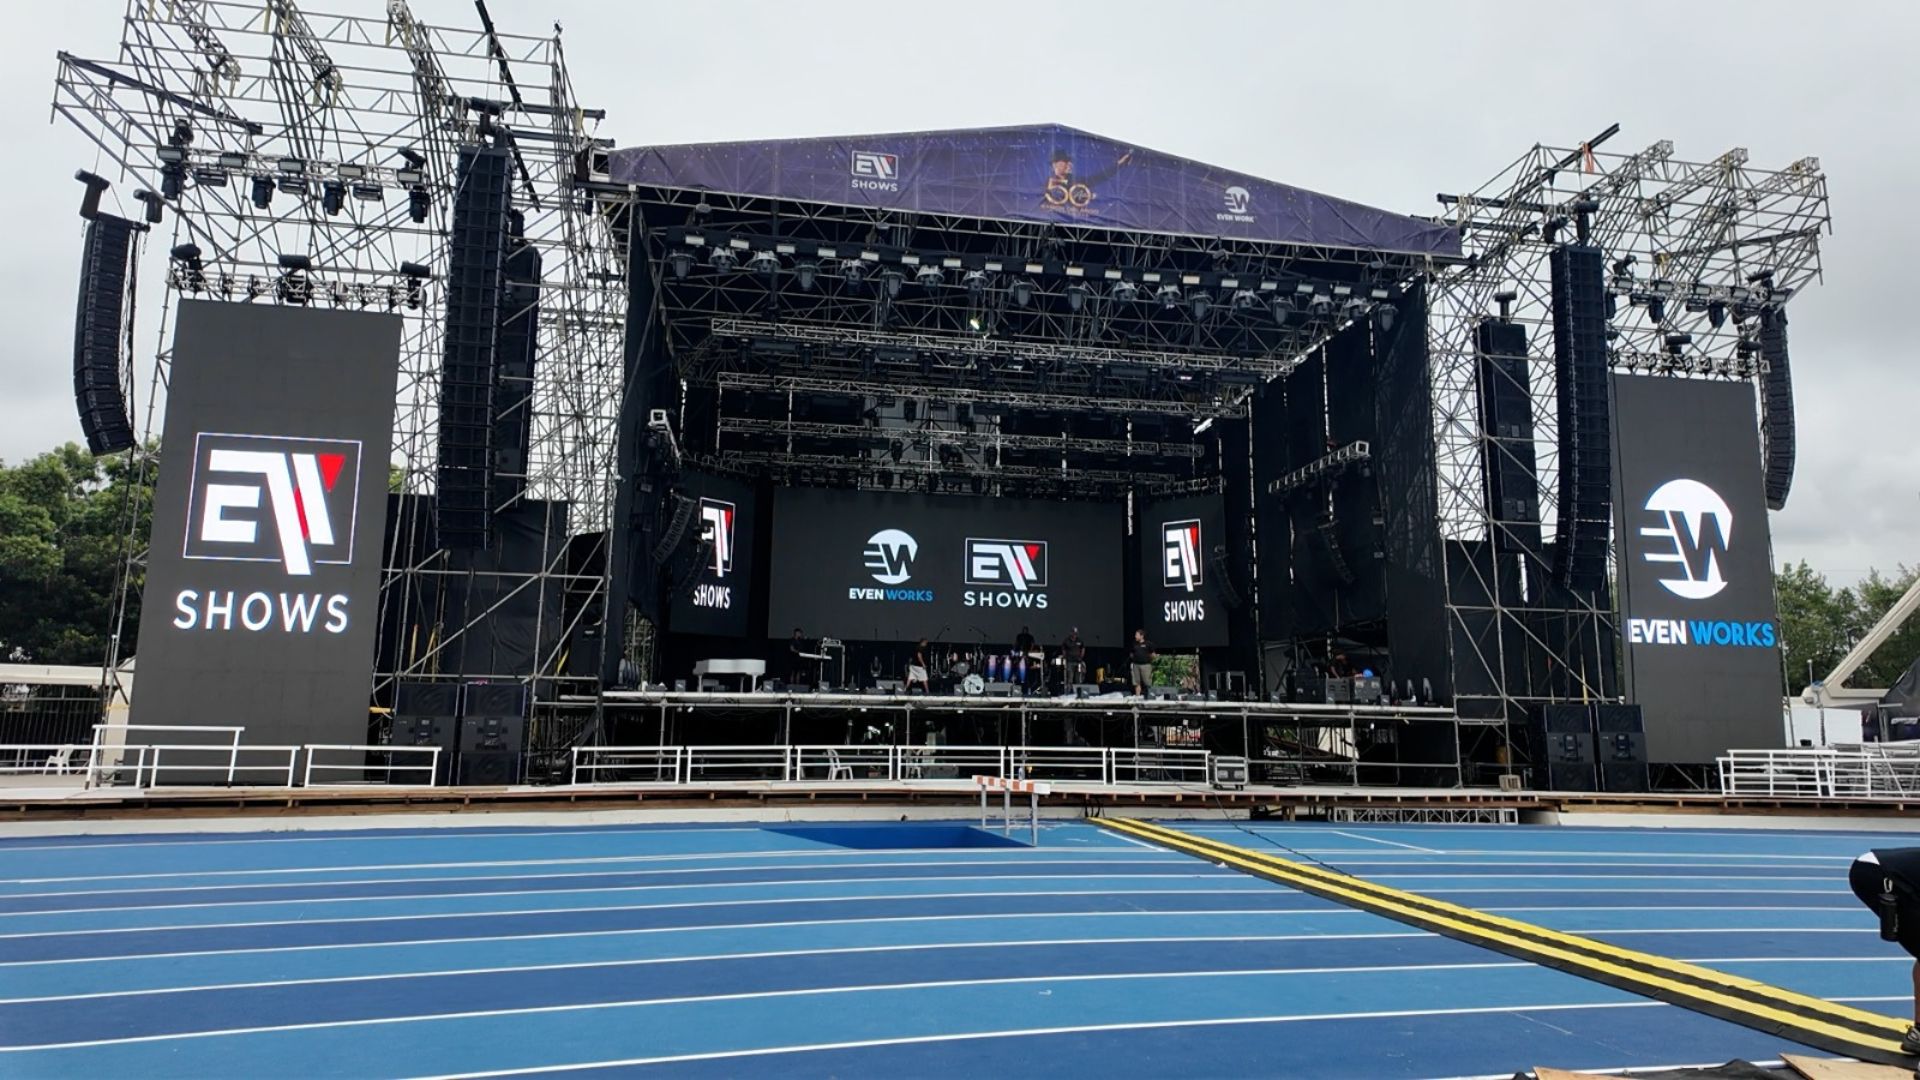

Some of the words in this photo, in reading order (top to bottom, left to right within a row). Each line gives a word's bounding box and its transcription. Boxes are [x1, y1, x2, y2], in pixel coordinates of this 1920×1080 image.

[851, 179, 899, 192] SHOWS
[693, 584, 731, 609] SHOWS
[849, 588, 884, 599] EVEN
[885, 589, 933, 601] WORKS
[964, 591, 1048, 609] SHOWS
[173, 589, 349, 634] SHOWS
[1164, 600, 1204, 622] SHOWS
[1627, 618, 1688, 645] EVEN
[1689, 620, 1777, 647] WORKS
